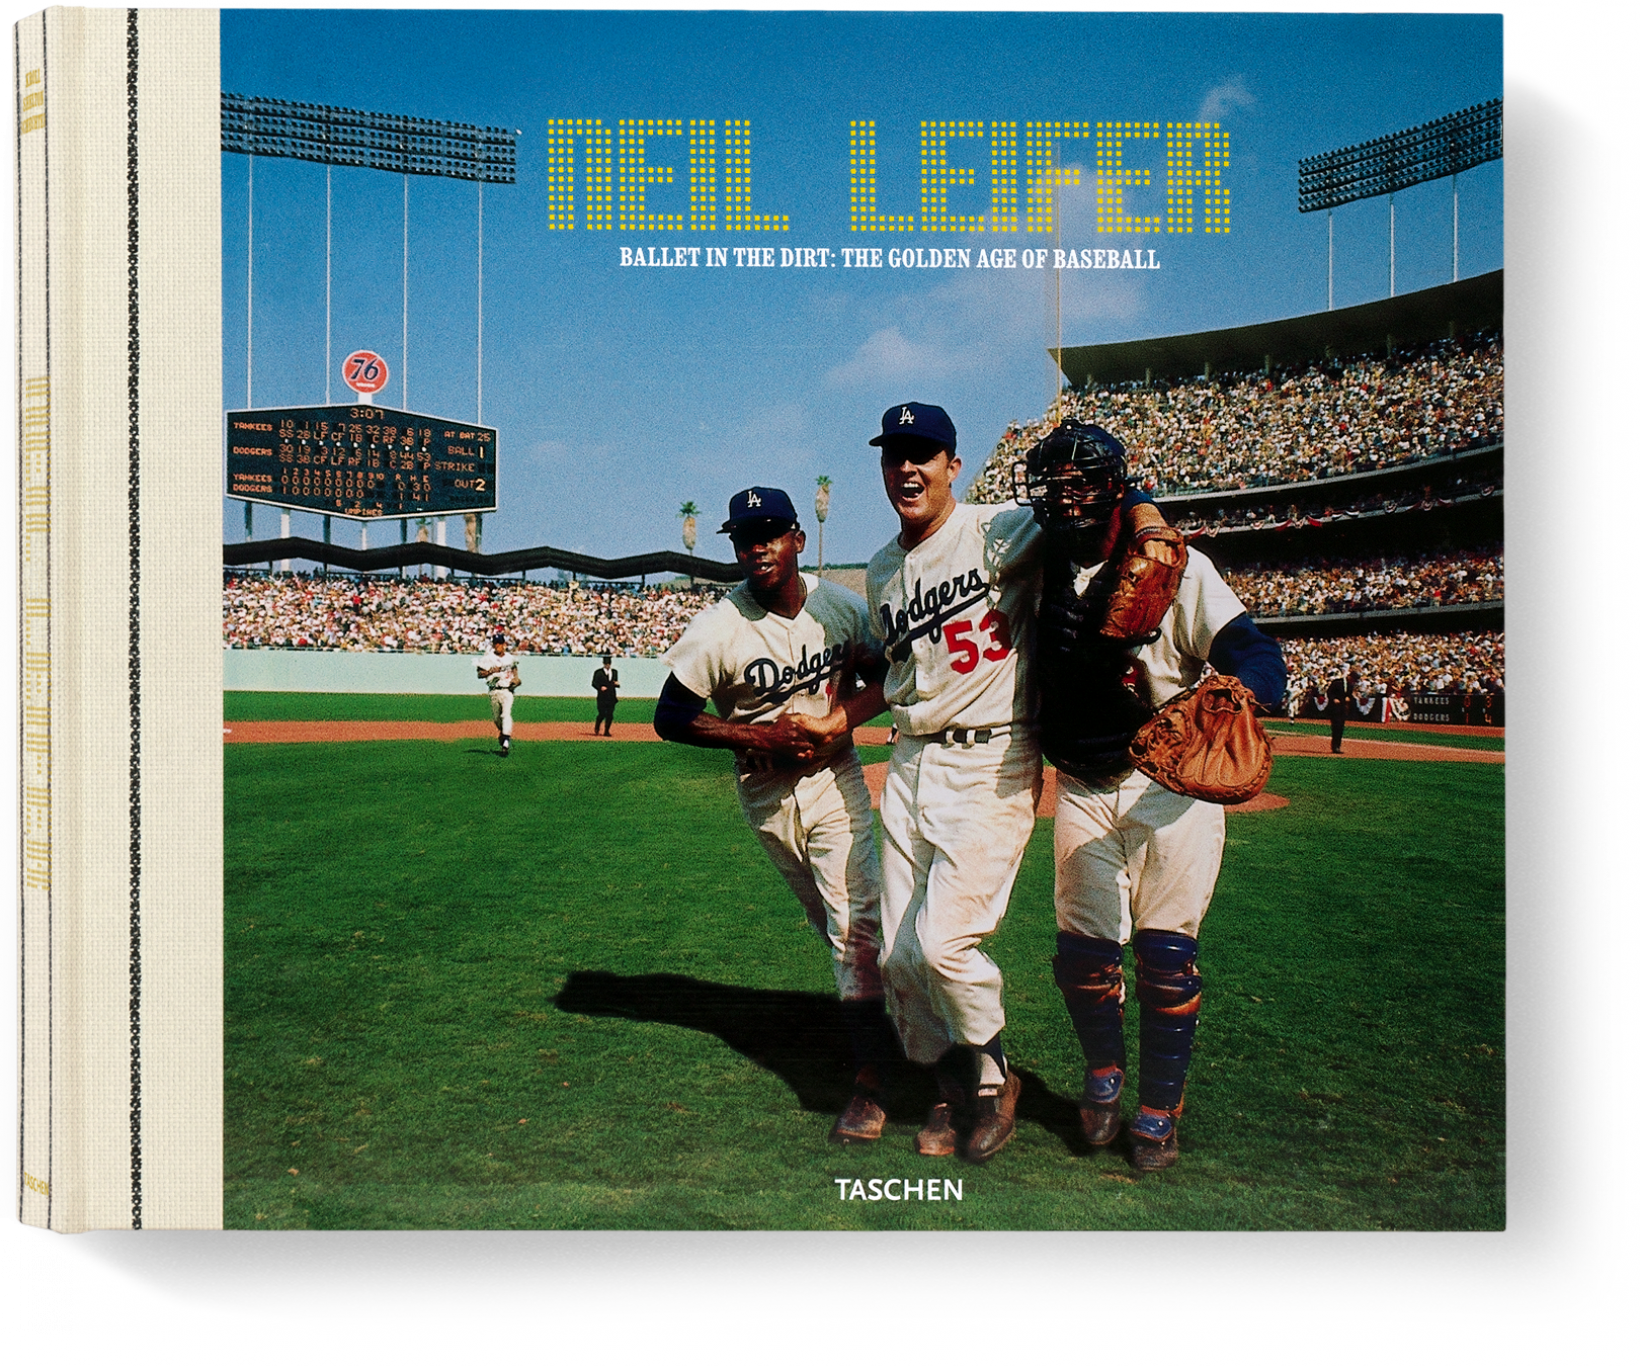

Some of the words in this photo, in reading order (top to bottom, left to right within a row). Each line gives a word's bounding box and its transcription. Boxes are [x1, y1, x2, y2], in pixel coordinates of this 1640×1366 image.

[547, 118, 790, 232] NEIL
[849, 120, 1231, 234] LEIFER
[619, 246, 701, 270] BALLET
[705, 246, 729, 270] IN
[733, 246, 775, 270] THE
[780, 246, 836, 270] DIRT:
[841, 246, 883, 270] THE
[888, 246, 972, 270] GOLDEN
[975, 246, 1017, 270] AGE
[1021, 246, 1049, 270] OF
[1052, 246, 1161, 270] BASEBALL
[349, 358, 380, 382] 76
[350, 408, 384, 420] 3:07
[899, 406, 915, 425] LA
[233, 422, 273, 432] YANKEES
[233, 446, 273, 456] DODGERS
[448, 446, 474, 456] BALL
[480, 446, 484, 459] 1
[434, 461, 475, 472] STRIKE
[233, 473, 272, 482] YANKEES
[281, 476, 289, 484] 0
[292, 476, 299, 485] 0
[303, 477, 310, 485] 0
[313, 477, 321, 486] 0
[324, 478, 332, 487] 0
[335, 478, 342, 487] 0
[346, 478, 353, 487] 0
[356, 479, 364, 488] 0
[367, 480, 375, 489] 0
[398, 482, 406, 491] 0
[413, 482, 420, 491] 3
[423, 483, 431, 492] 0
[454, 479, 475, 488] OUT
[475, 478, 486, 491] 2
[233, 484, 272, 493] DODGERS
[292, 486, 300, 495] 0
[302, 487, 310, 496] 0
[313, 487, 321, 496] 0
[324, 487, 332, 497] 0
[335, 488, 342, 497] 0
[346, 489, 354, 498] 0
[356, 489, 364, 498] 0
[413, 492, 420, 501] 4
[746, 489, 762, 508] LA
[943, 609, 1013, 675] 53
[834, 1178, 963, 1201] TASCHEN
